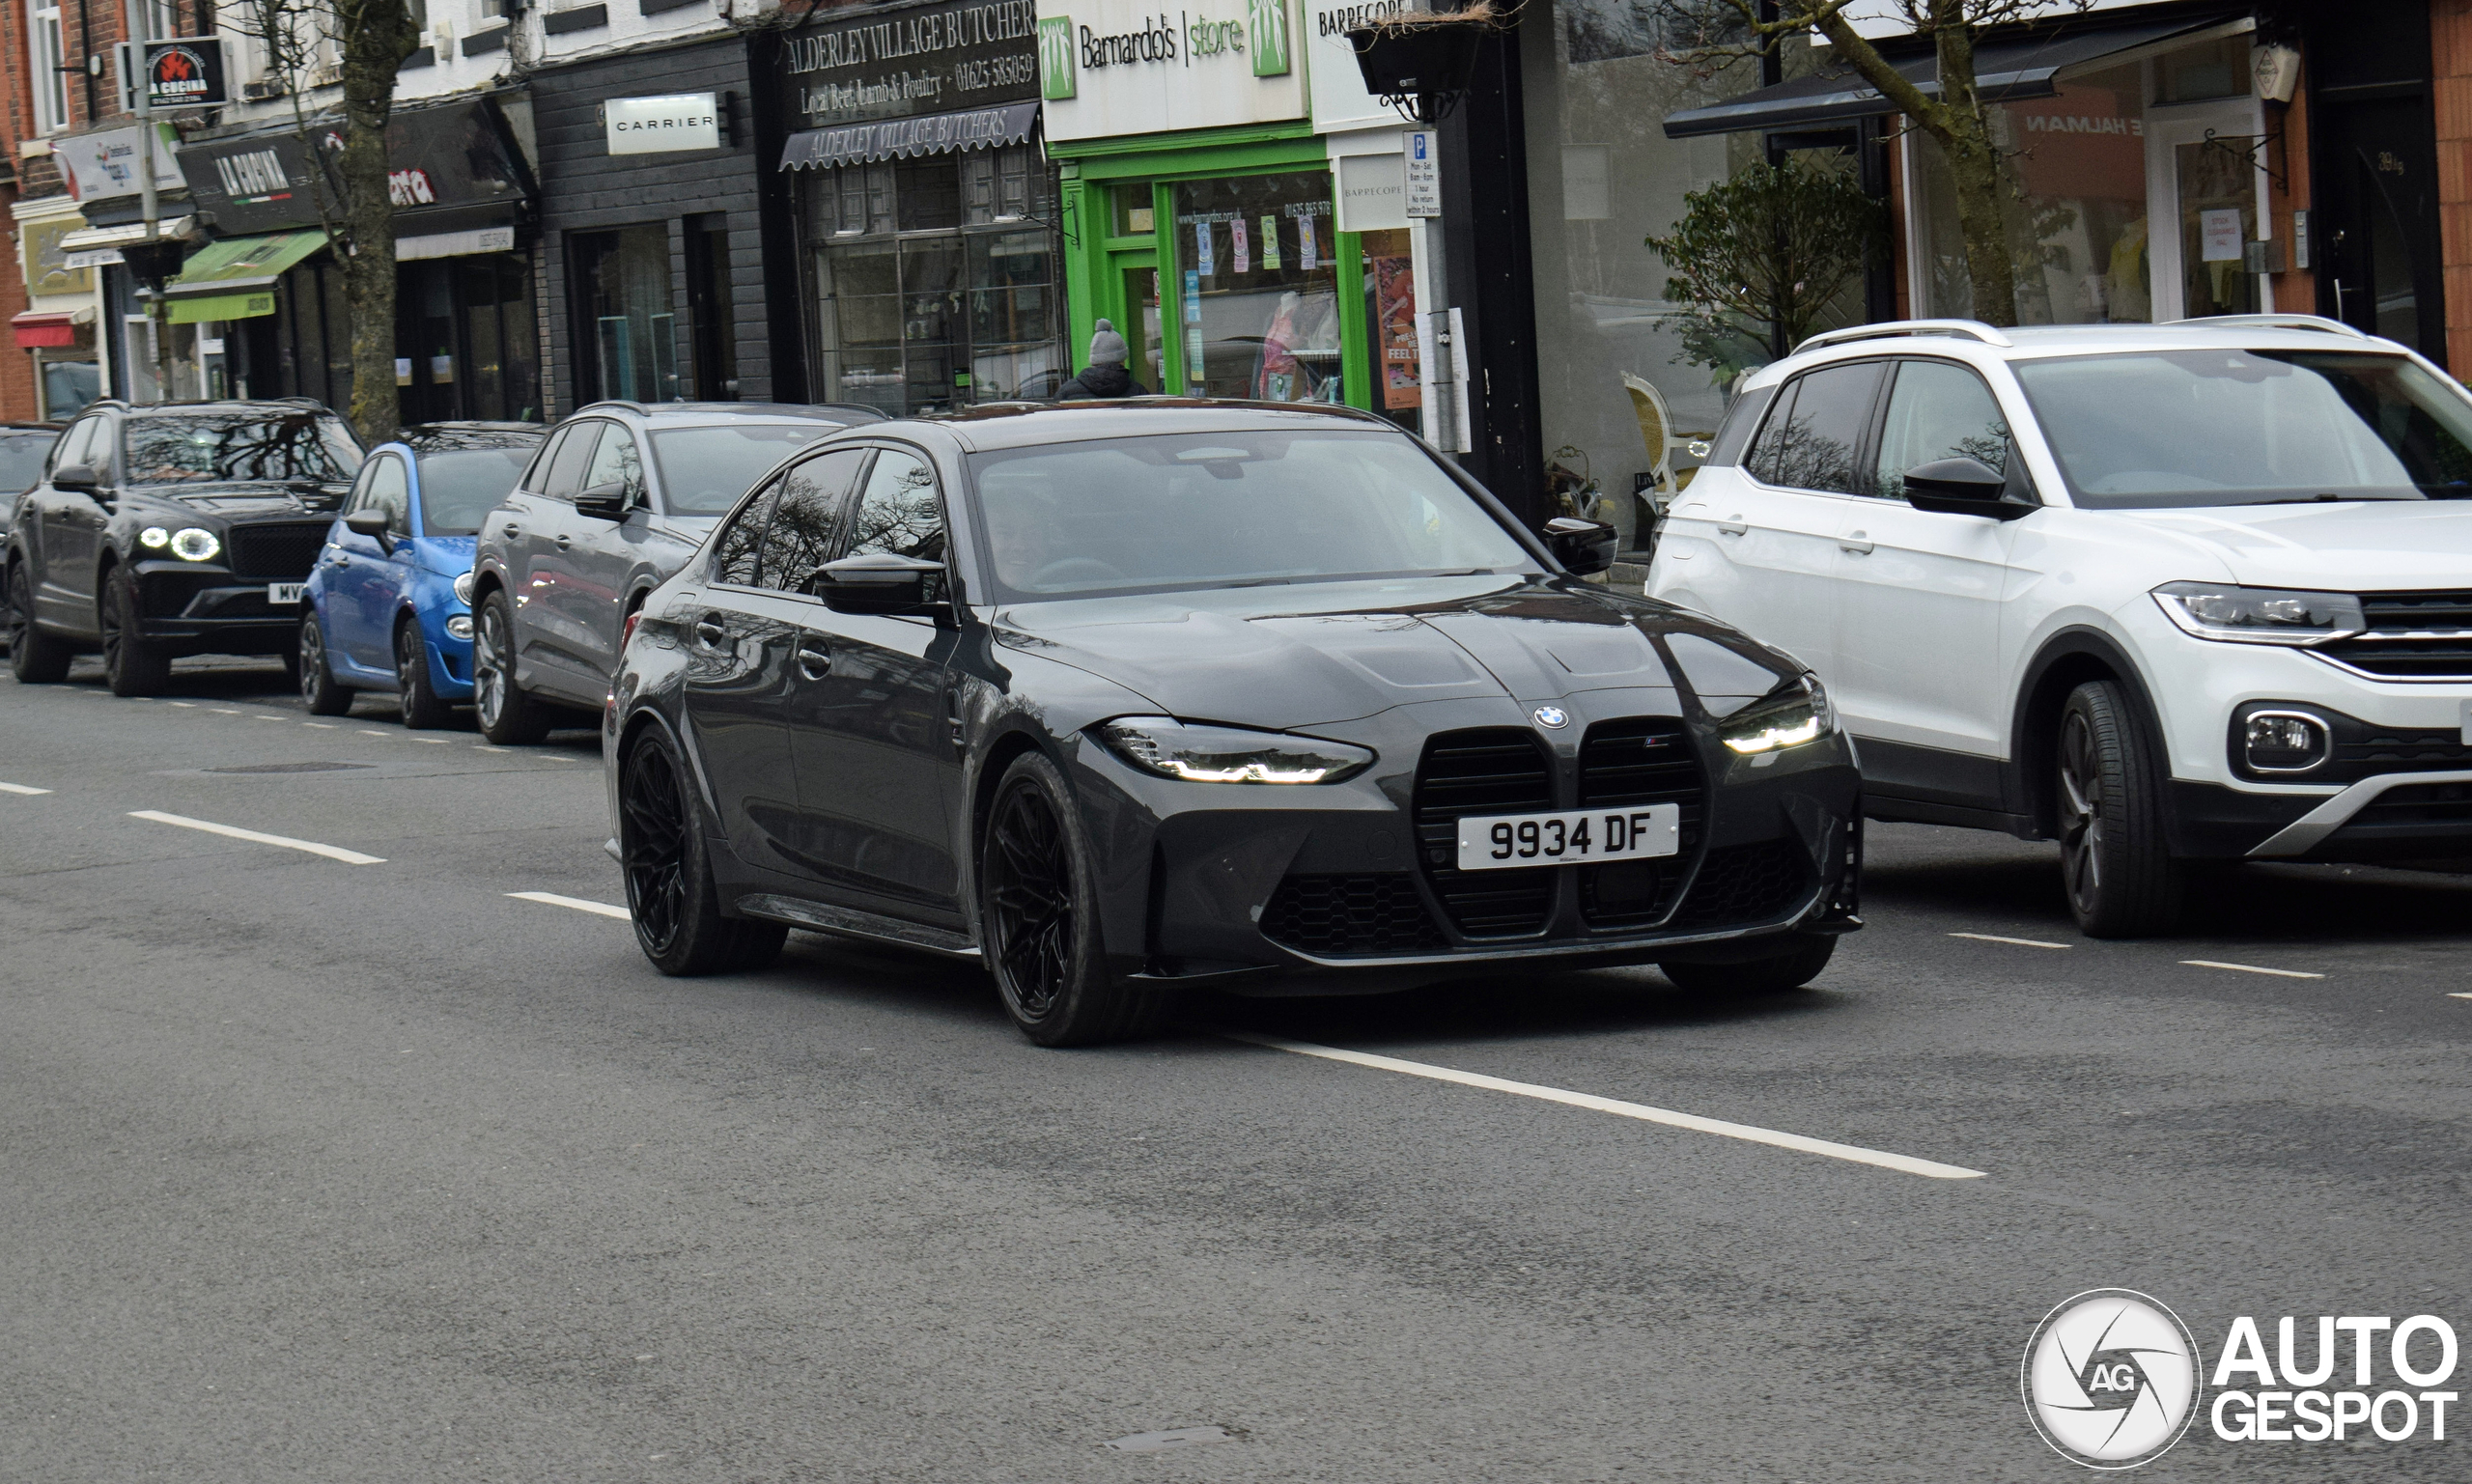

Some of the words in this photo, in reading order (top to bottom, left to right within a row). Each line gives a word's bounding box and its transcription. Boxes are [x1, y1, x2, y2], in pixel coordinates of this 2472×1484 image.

[788, 27, 867, 74] ALDERLEY
[870, 14, 944, 60] VILLAGE
[1080, 14, 1175, 69] Barnardo's
[1190, 14, 1244, 56] store
[160, 79, 208, 94] CUCINA
[801, 88, 829, 113] Local
[830, 80, 857, 111] Beef,
[857, 77, 888, 105] Lamb
[889, 73, 900, 101] &
[902, 71, 941, 103] Poultry
[954, 60, 991, 92] 01625
[992, 53, 1035, 87] 585059
[617, 116, 714, 131] CARRIER
[810, 126, 877, 158] ALDERLEY
[880, 117, 932, 149] VILLAGE
[937, 109, 1008, 142] BUTCHERS
[1416, 137, 1424, 157] P
[1419, 195, 1434, 204] return
[1285, 202, 1304, 218] 01625
[1389, 349, 1411, 359] FEEL
[280, 585, 304, 600] MV
[1491, 818, 1591, 859] 9934
[1604, 812, 1650, 853] DF
